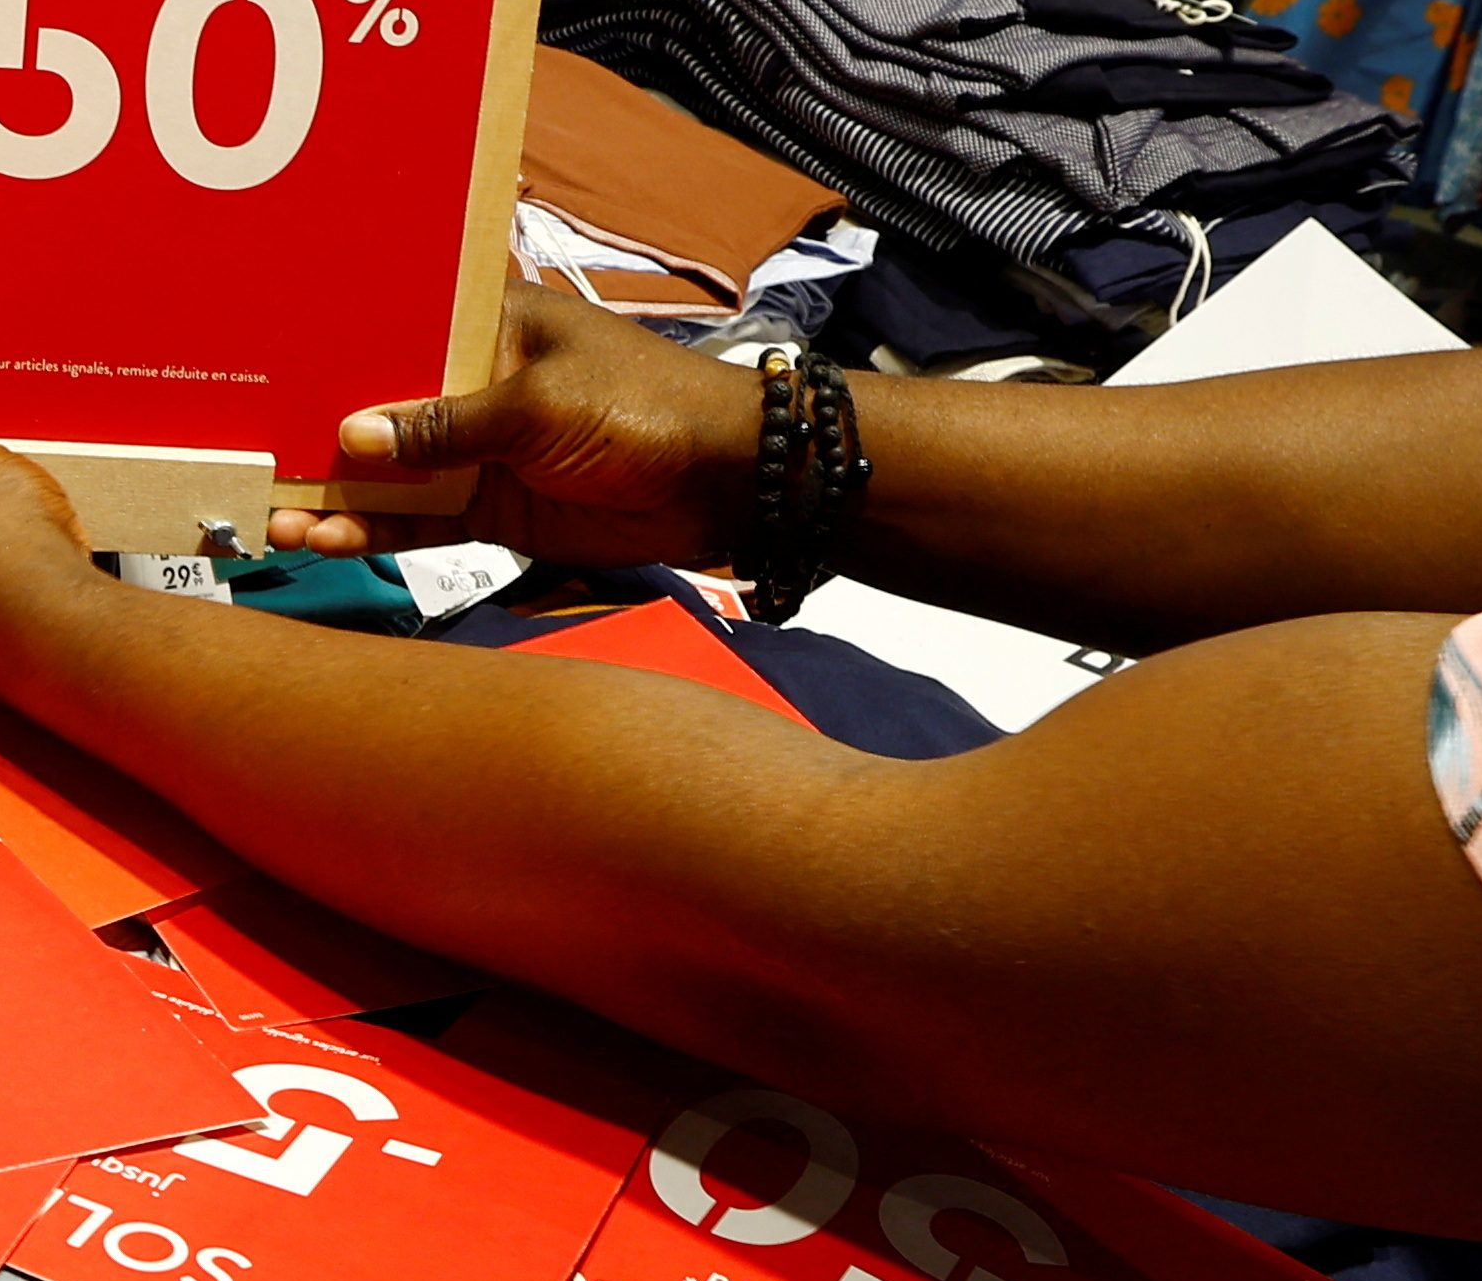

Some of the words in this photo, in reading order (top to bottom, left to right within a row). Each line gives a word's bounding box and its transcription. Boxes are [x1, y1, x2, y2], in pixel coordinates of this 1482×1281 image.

[13, 357, 59, 372] articles
[61, 360, 114, 378] signalés,
[117, 364, 159, 378] remise
[161, 365, 209, 381] déduite
[212, 372, 227, 381] en
[229, 369, 270, 384] caisse.
